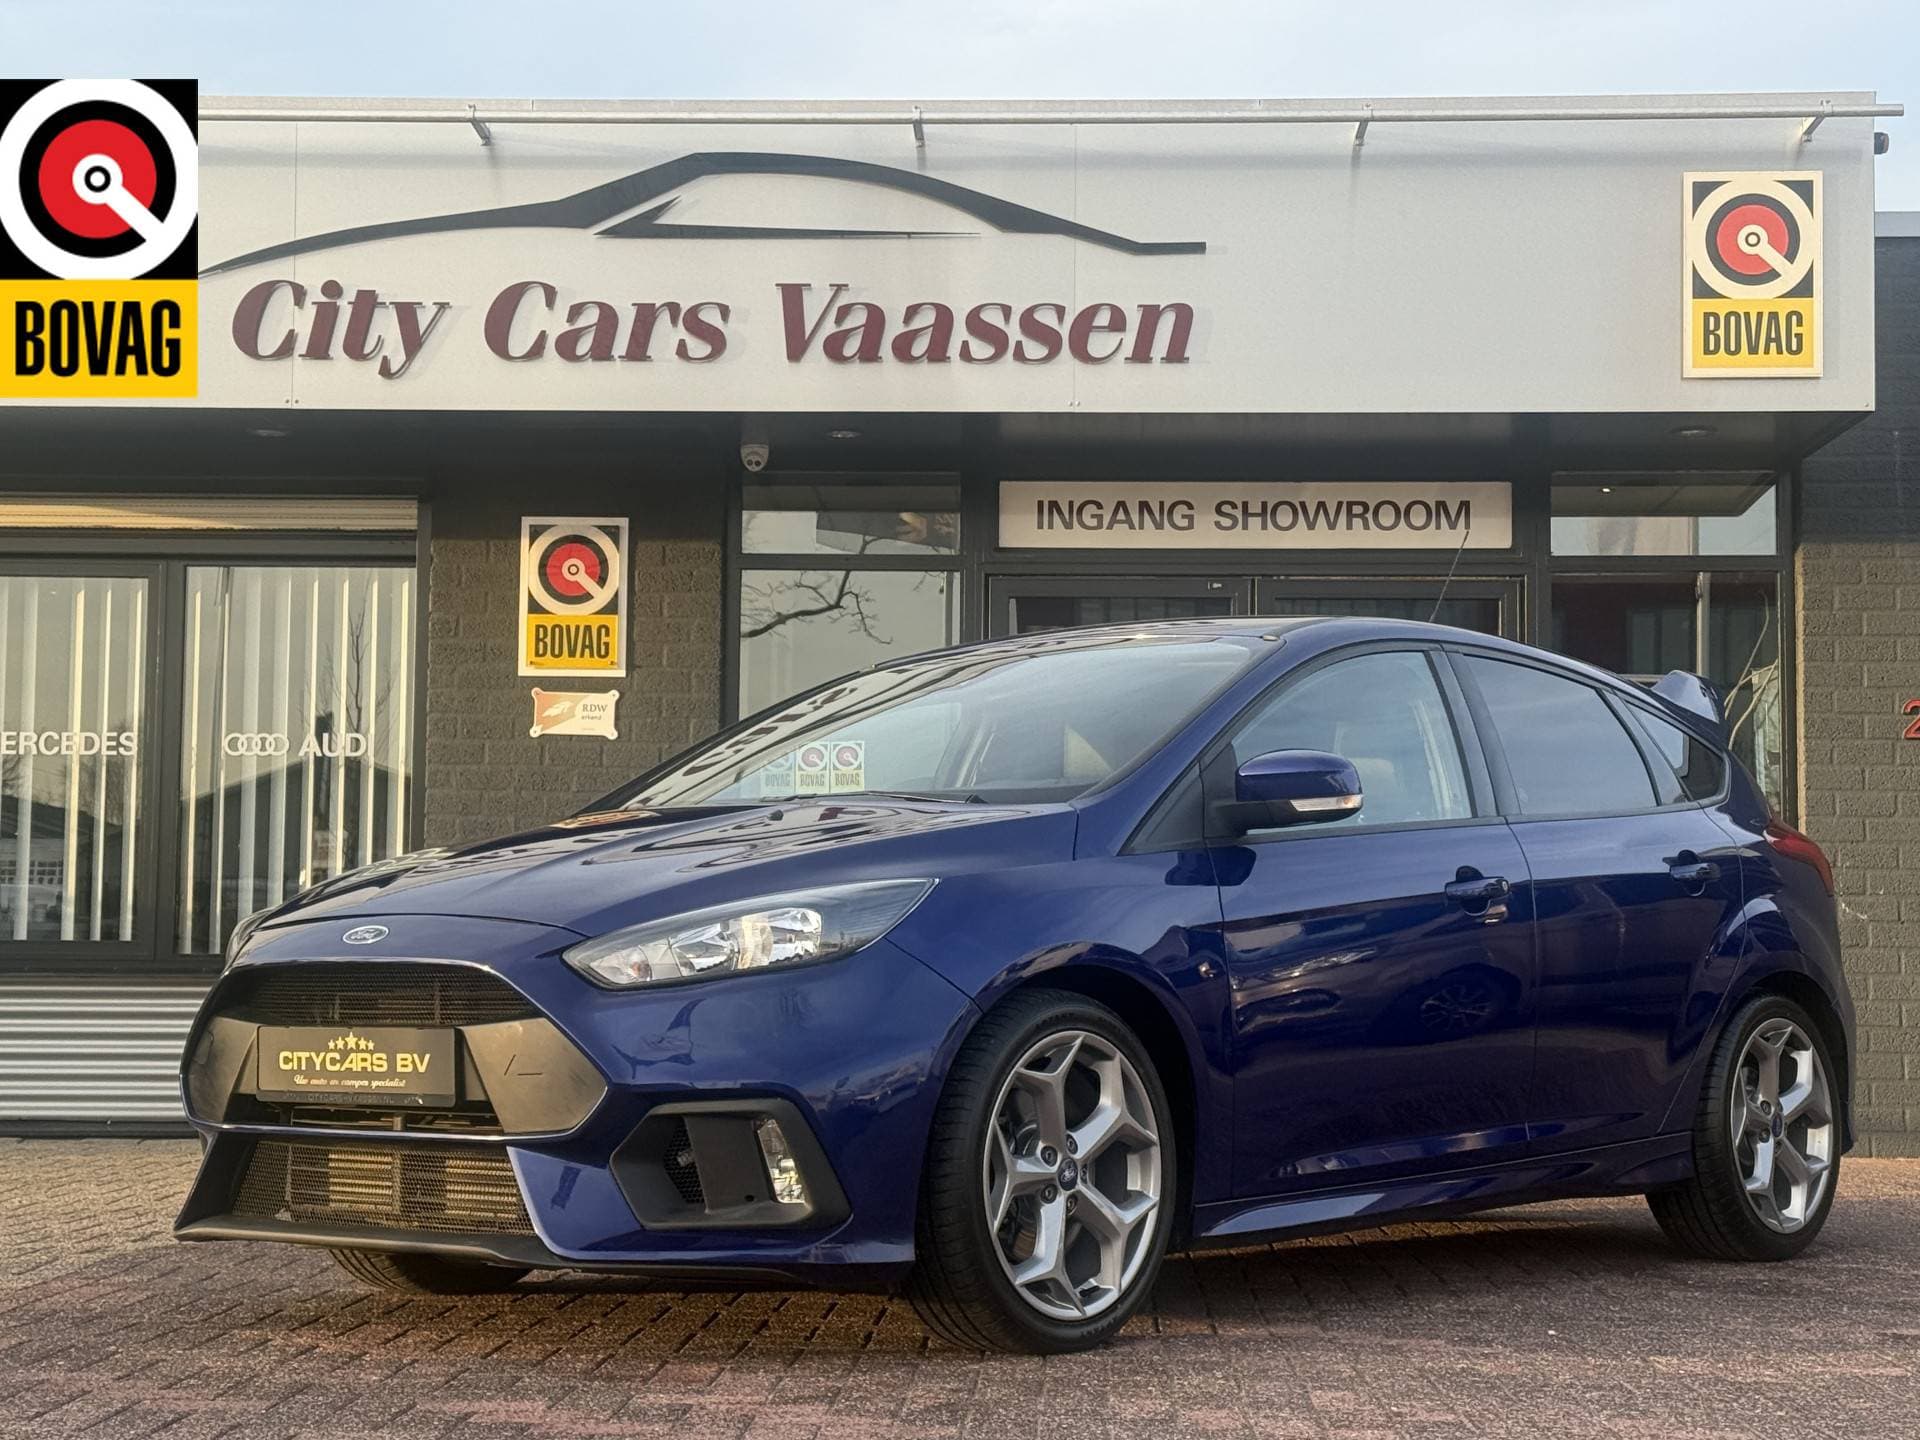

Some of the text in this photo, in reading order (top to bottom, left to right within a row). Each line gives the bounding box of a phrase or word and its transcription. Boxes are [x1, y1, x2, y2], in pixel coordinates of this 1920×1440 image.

[232, 280, 1195, 379] City Cars Vaassen
[1702, 310, 1804, 356] BOVAG
[1036, 499, 1471, 531] INGANG SHOWROOM
[534, 624, 610, 659] BOVAG
[582, 703, 608, 713] RDW
[299, 733, 375, 757] AUDI
[799, 773, 825, 787] BOVAG
[835, 772, 860, 786] BOVAG
[278, 1051, 431, 1073] CITYCARS BV
